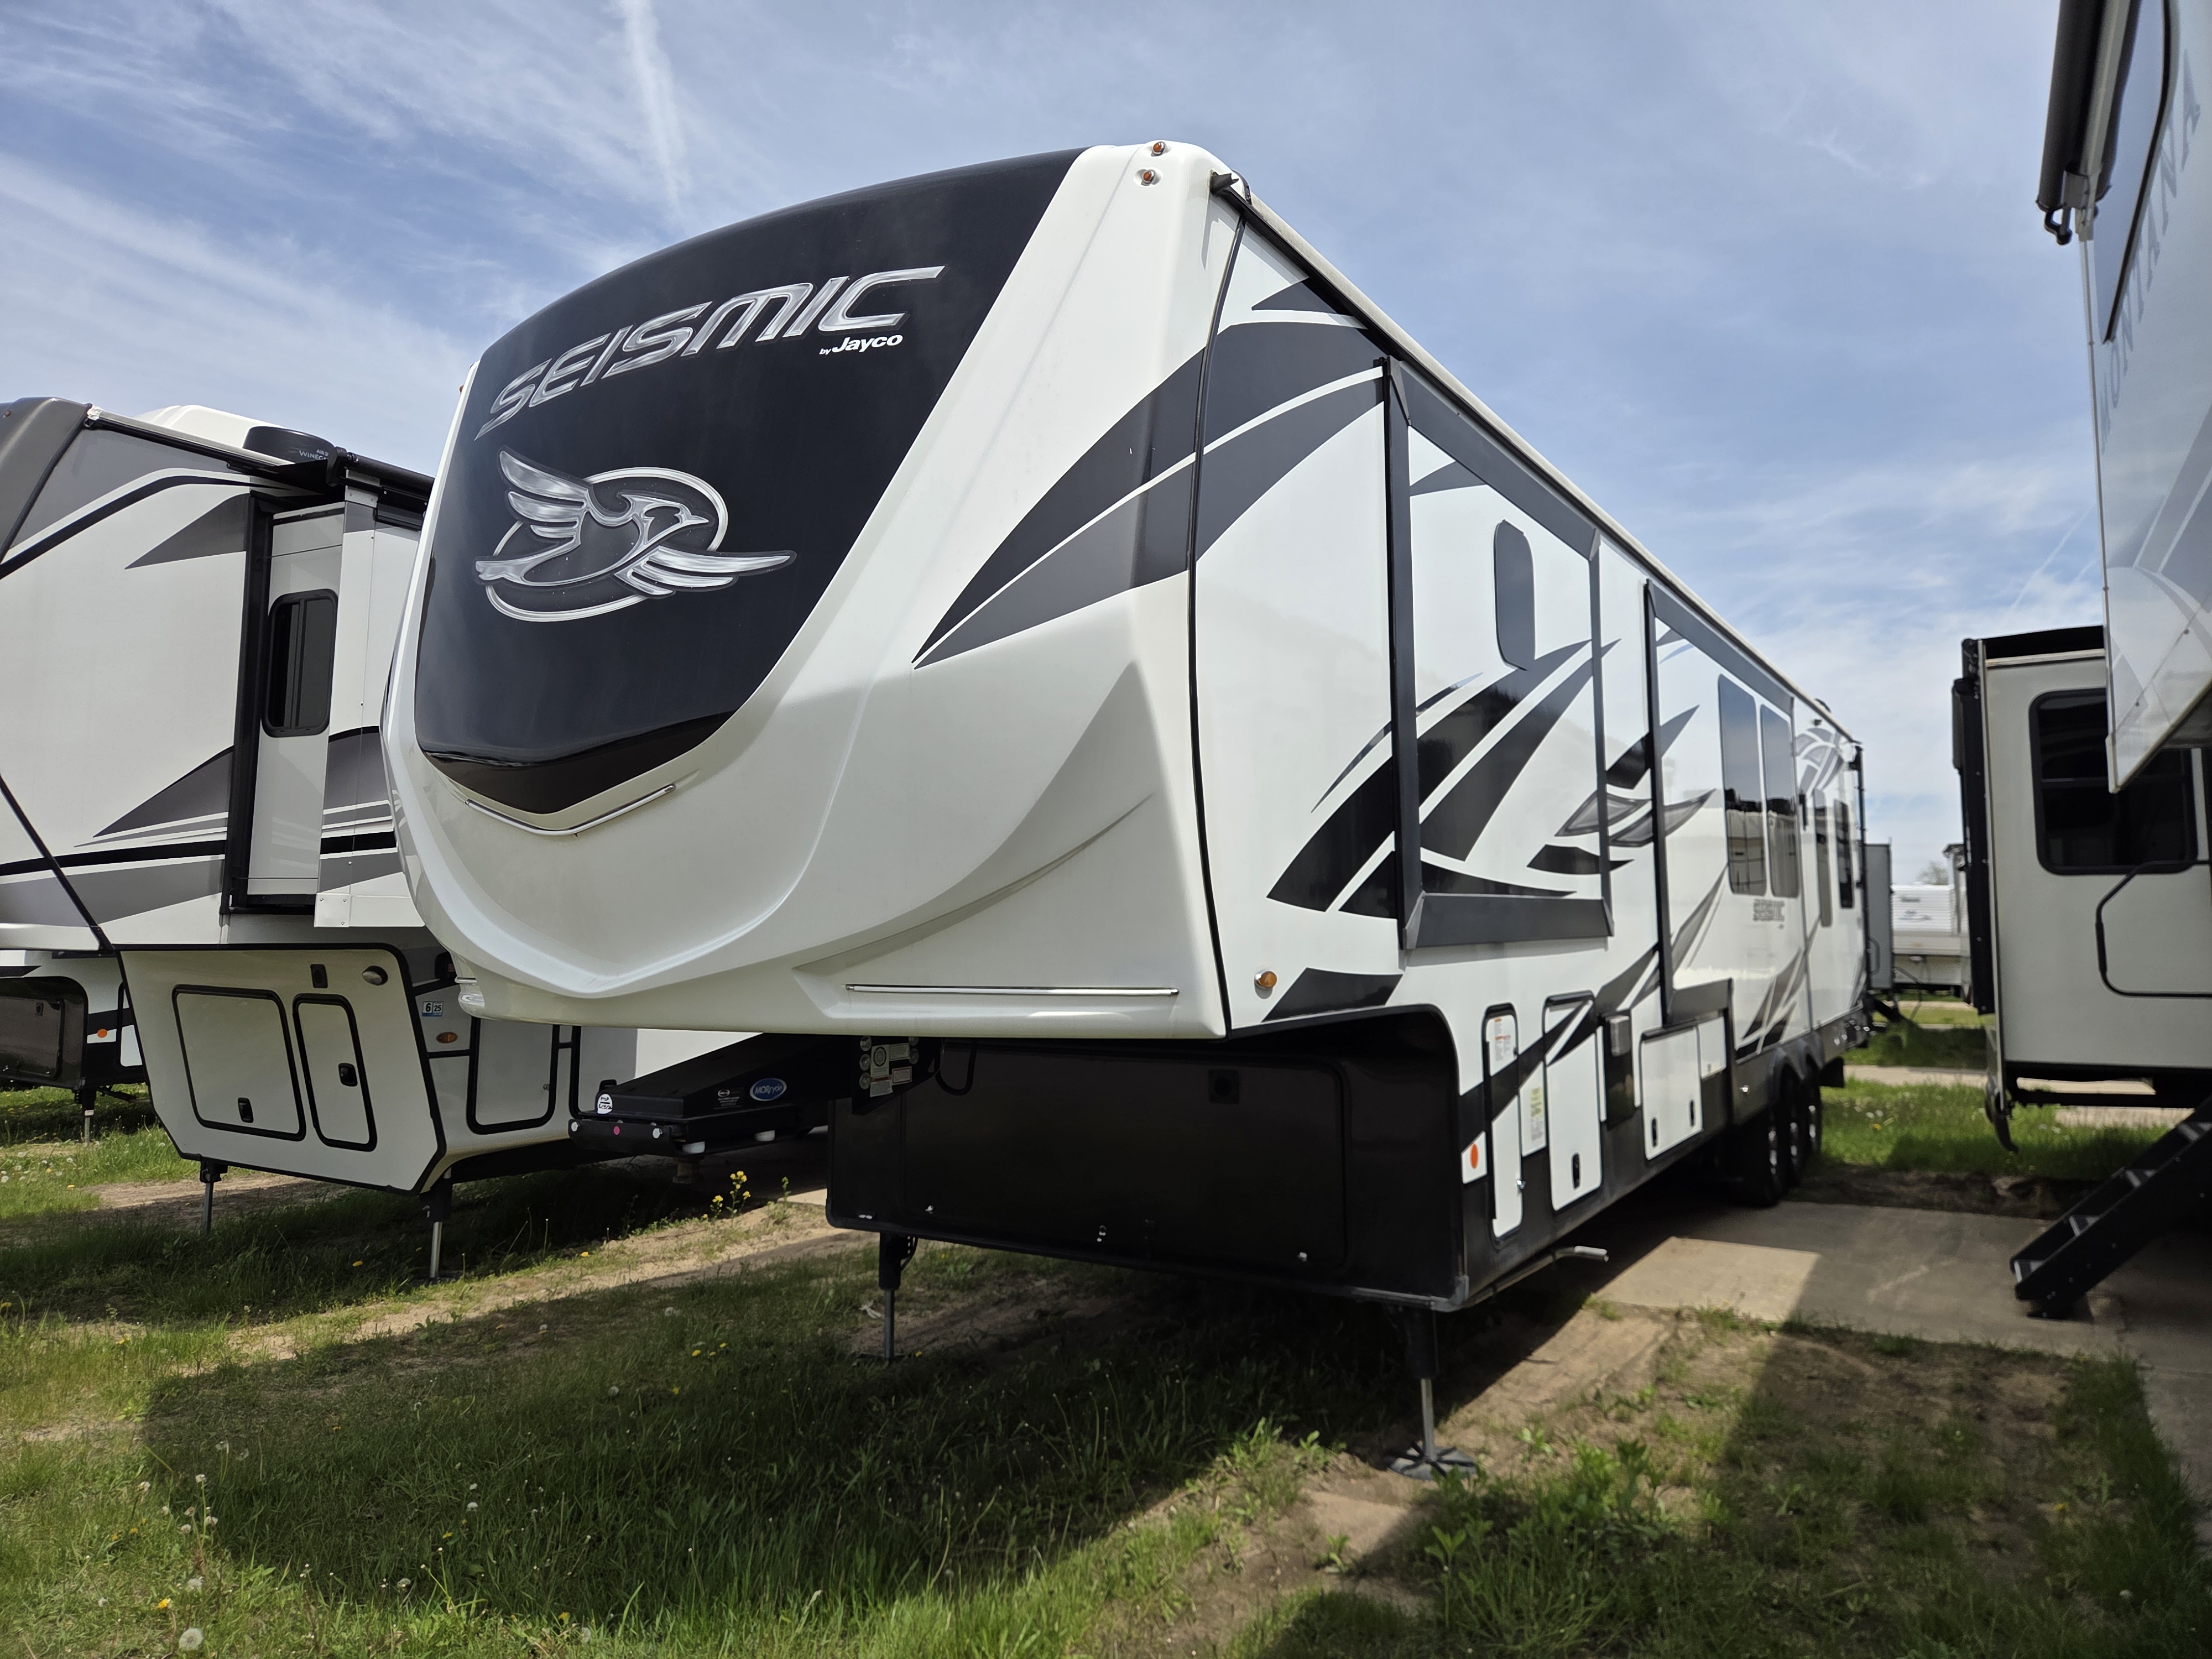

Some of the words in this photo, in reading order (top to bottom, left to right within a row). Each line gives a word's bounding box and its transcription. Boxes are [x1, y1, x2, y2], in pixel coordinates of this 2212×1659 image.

[832, 335, 903, 352] Jayco
[474, 265, 945, 441] SEISMIC
[425, 1003, 431, 1012] 6
